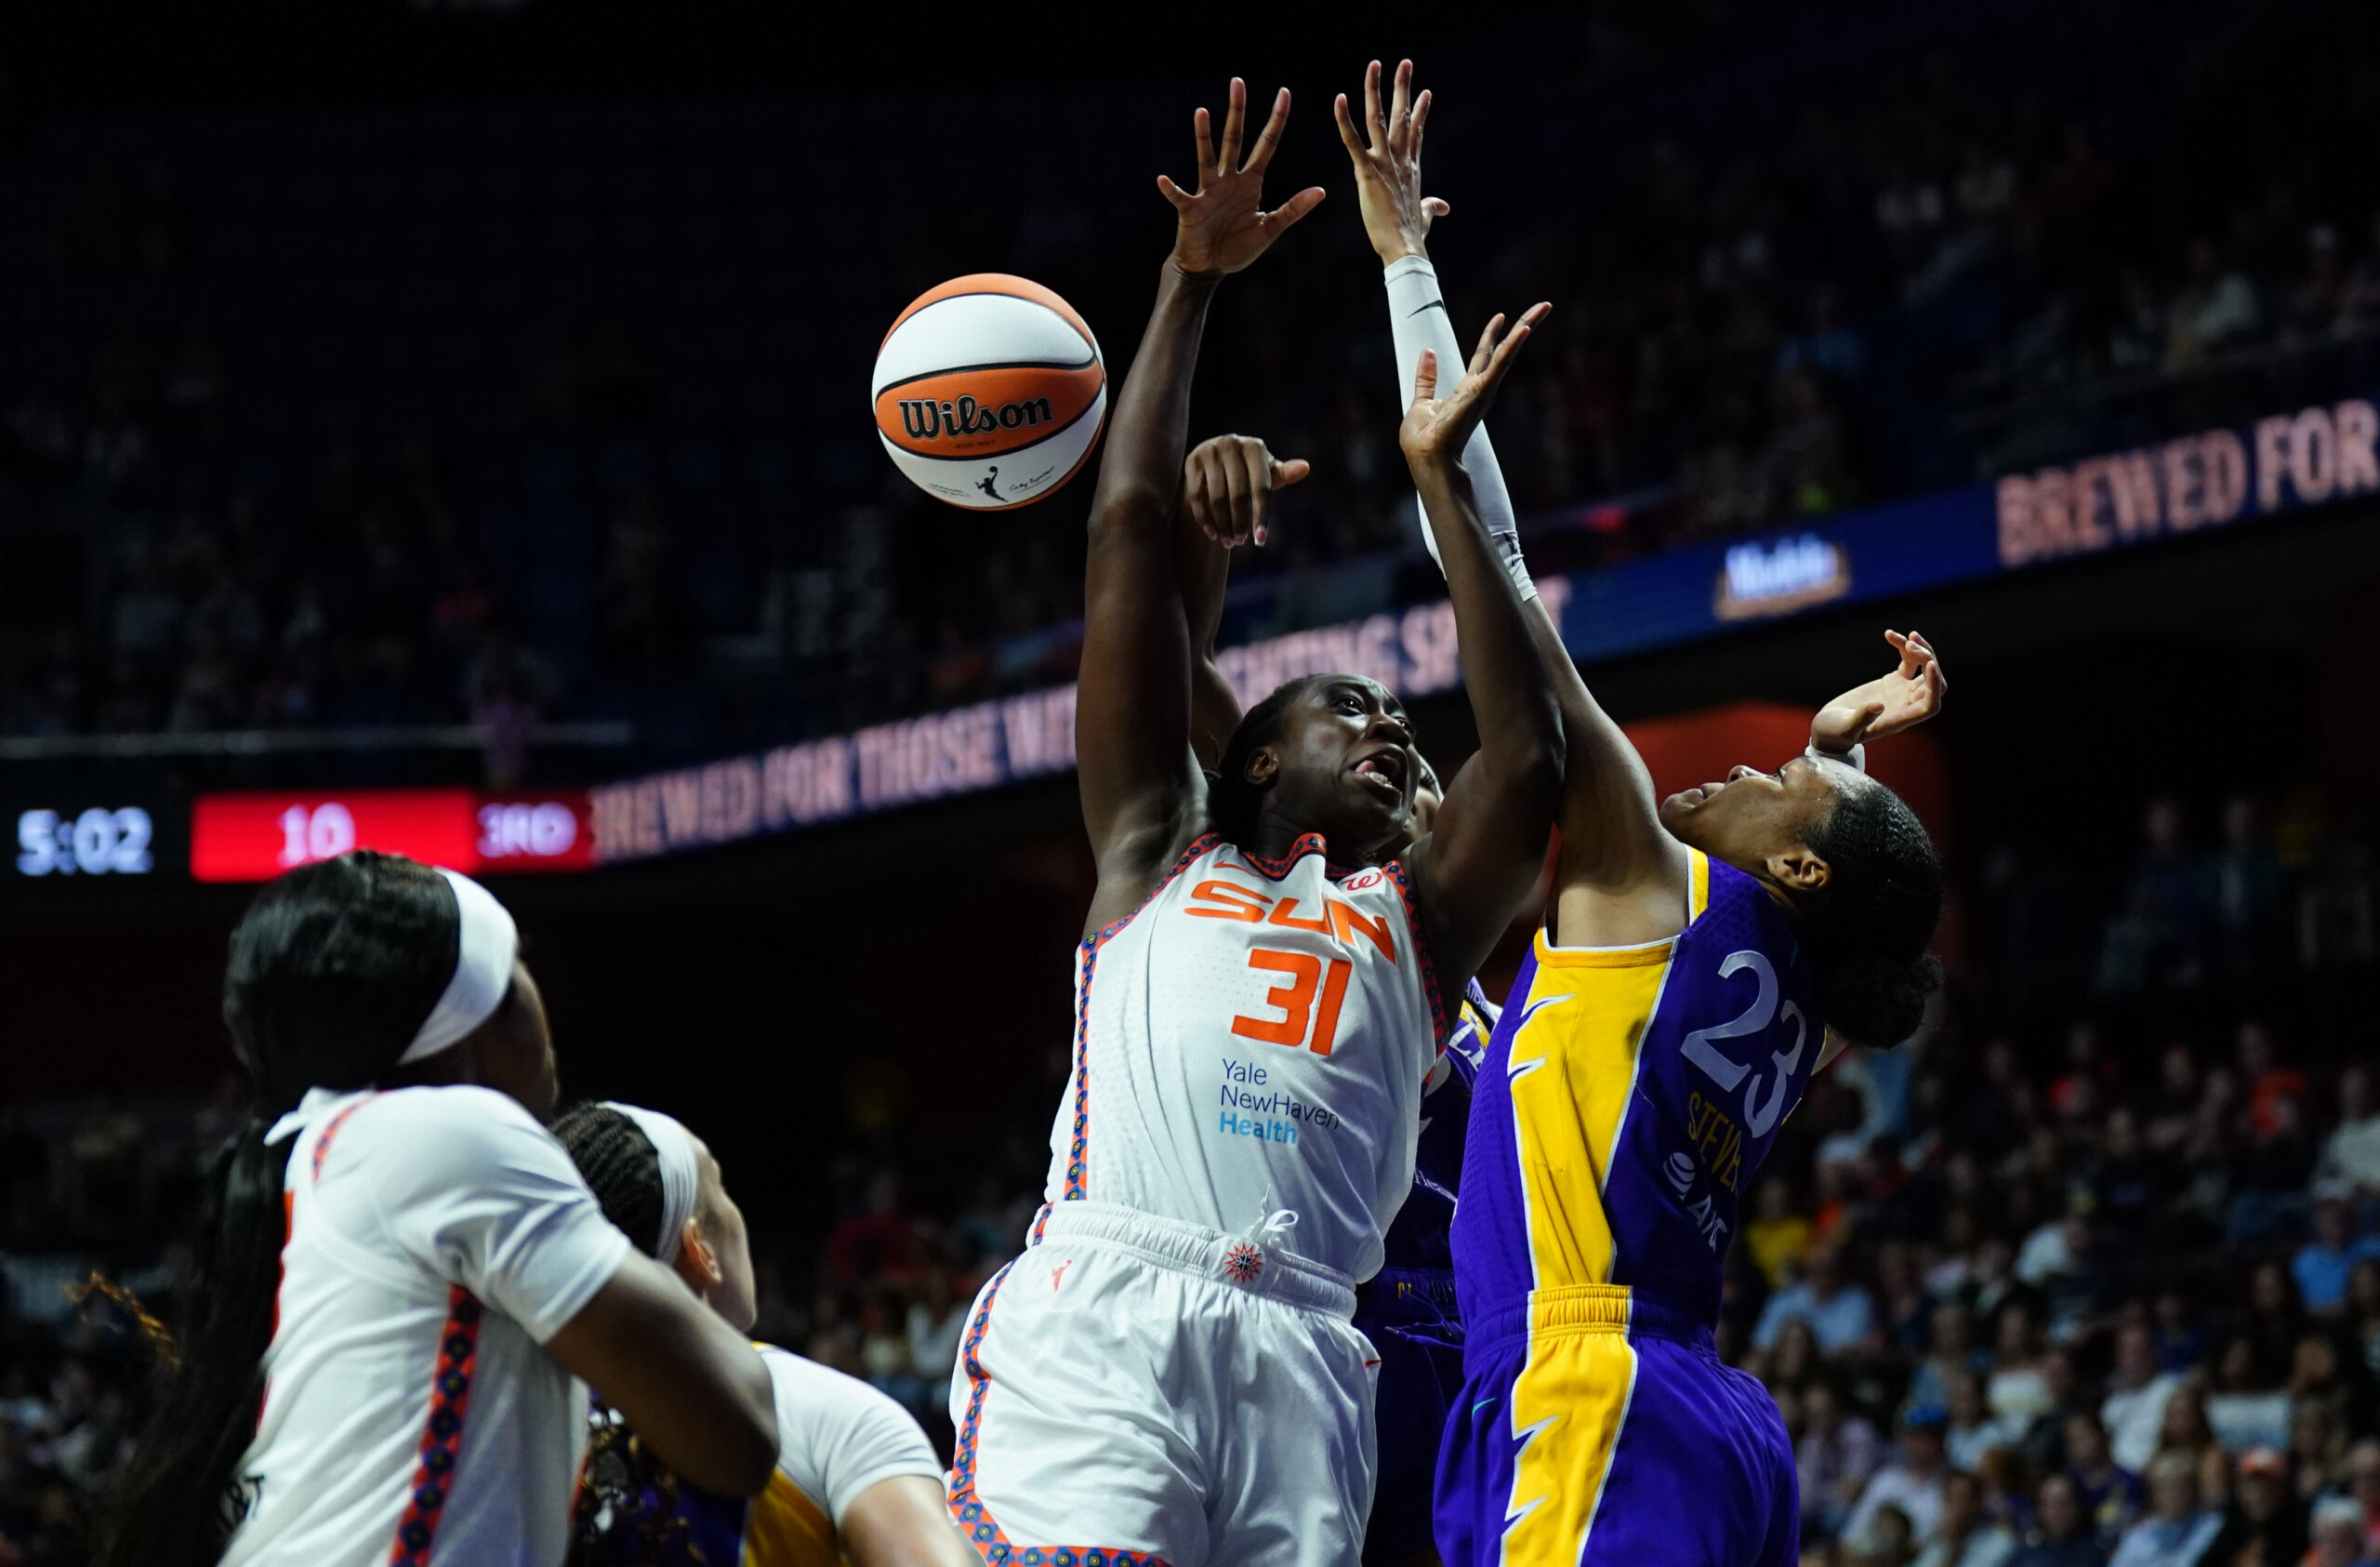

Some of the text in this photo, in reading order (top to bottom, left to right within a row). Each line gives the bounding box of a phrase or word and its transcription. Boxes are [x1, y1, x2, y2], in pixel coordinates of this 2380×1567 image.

[898, 394, 1054, 440] Wilson
[1996, 399, 2378, 568] BREWED FOR
[762, 737, 853, 827] FOR
[854, 698, 1003, 812] THOSE
[18, 807, 154, 876] 5:02
[278, 802, 356, 868] 10
[1183, 880, 1396, 965] SUN
[1231, 948, 1353, 1056] 31
[1680, 949, 1806, 1138] 23
[1223, 1058, 1267, 1085] Yale
[1220, 1111, 1298, 1145] Health
[1688, 1092, 1741, 1195] STEVE
